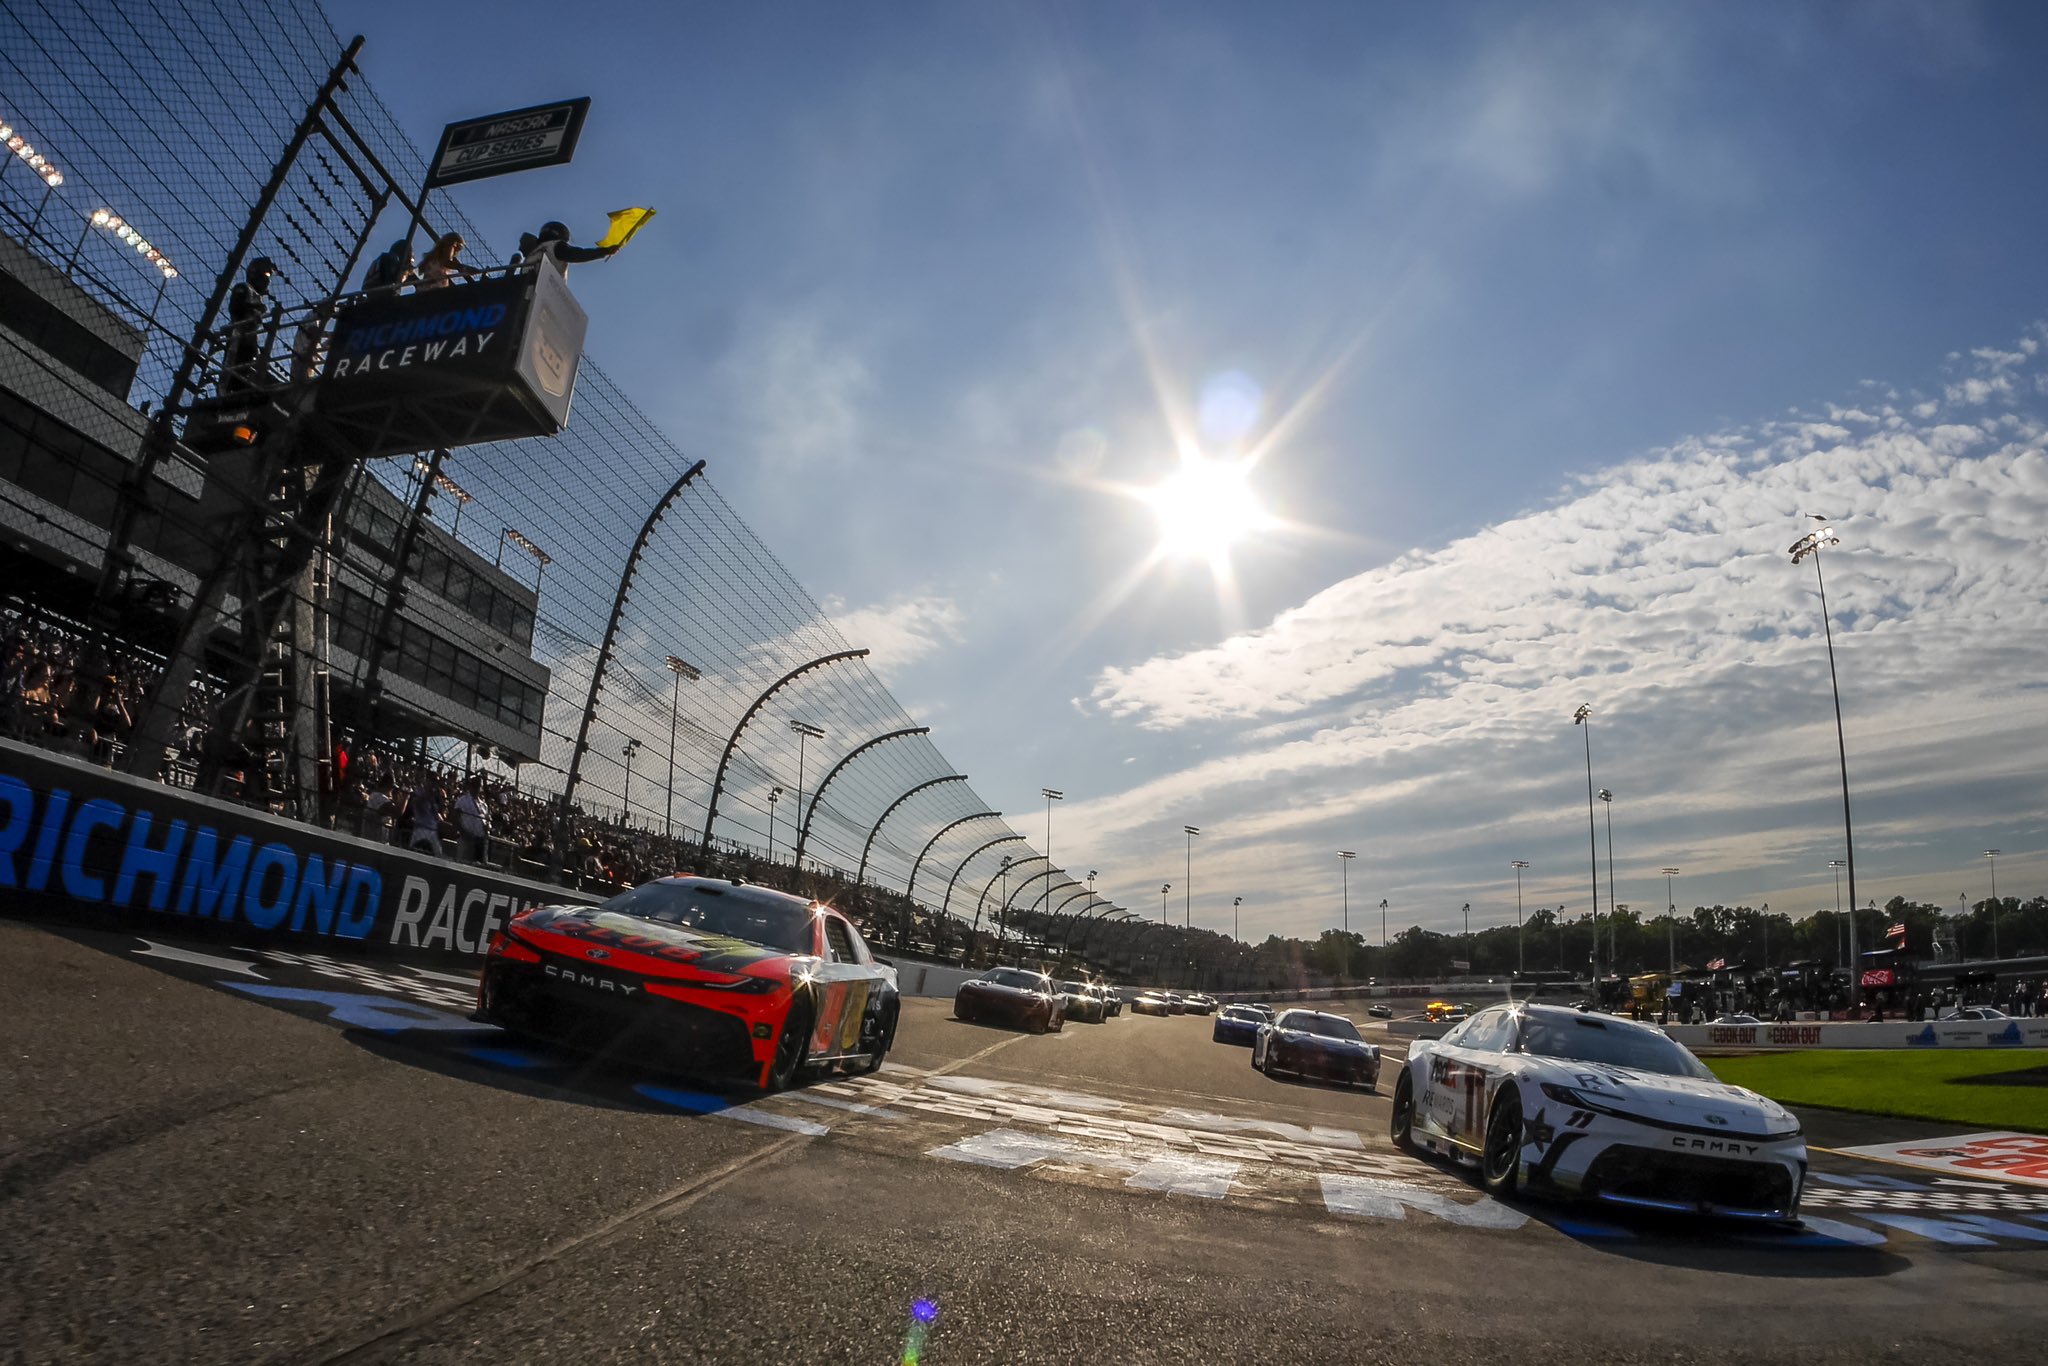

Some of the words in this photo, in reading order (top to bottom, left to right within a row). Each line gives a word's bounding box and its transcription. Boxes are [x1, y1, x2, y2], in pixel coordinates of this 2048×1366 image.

[485, 113, 553, 139] NASCAR
[456, 145, 492, 163] CUP
[489, 133, 547, 157] SERIES
[345, 303, 507, 350] RICHMOND
[333, 332, 495, 378] RACEWAY
[545, 965, 638, 995] CAMRY
[1565, 1110, 1598, 1129] 11
[1672, 1136, 1759, 1156] CAMRY
